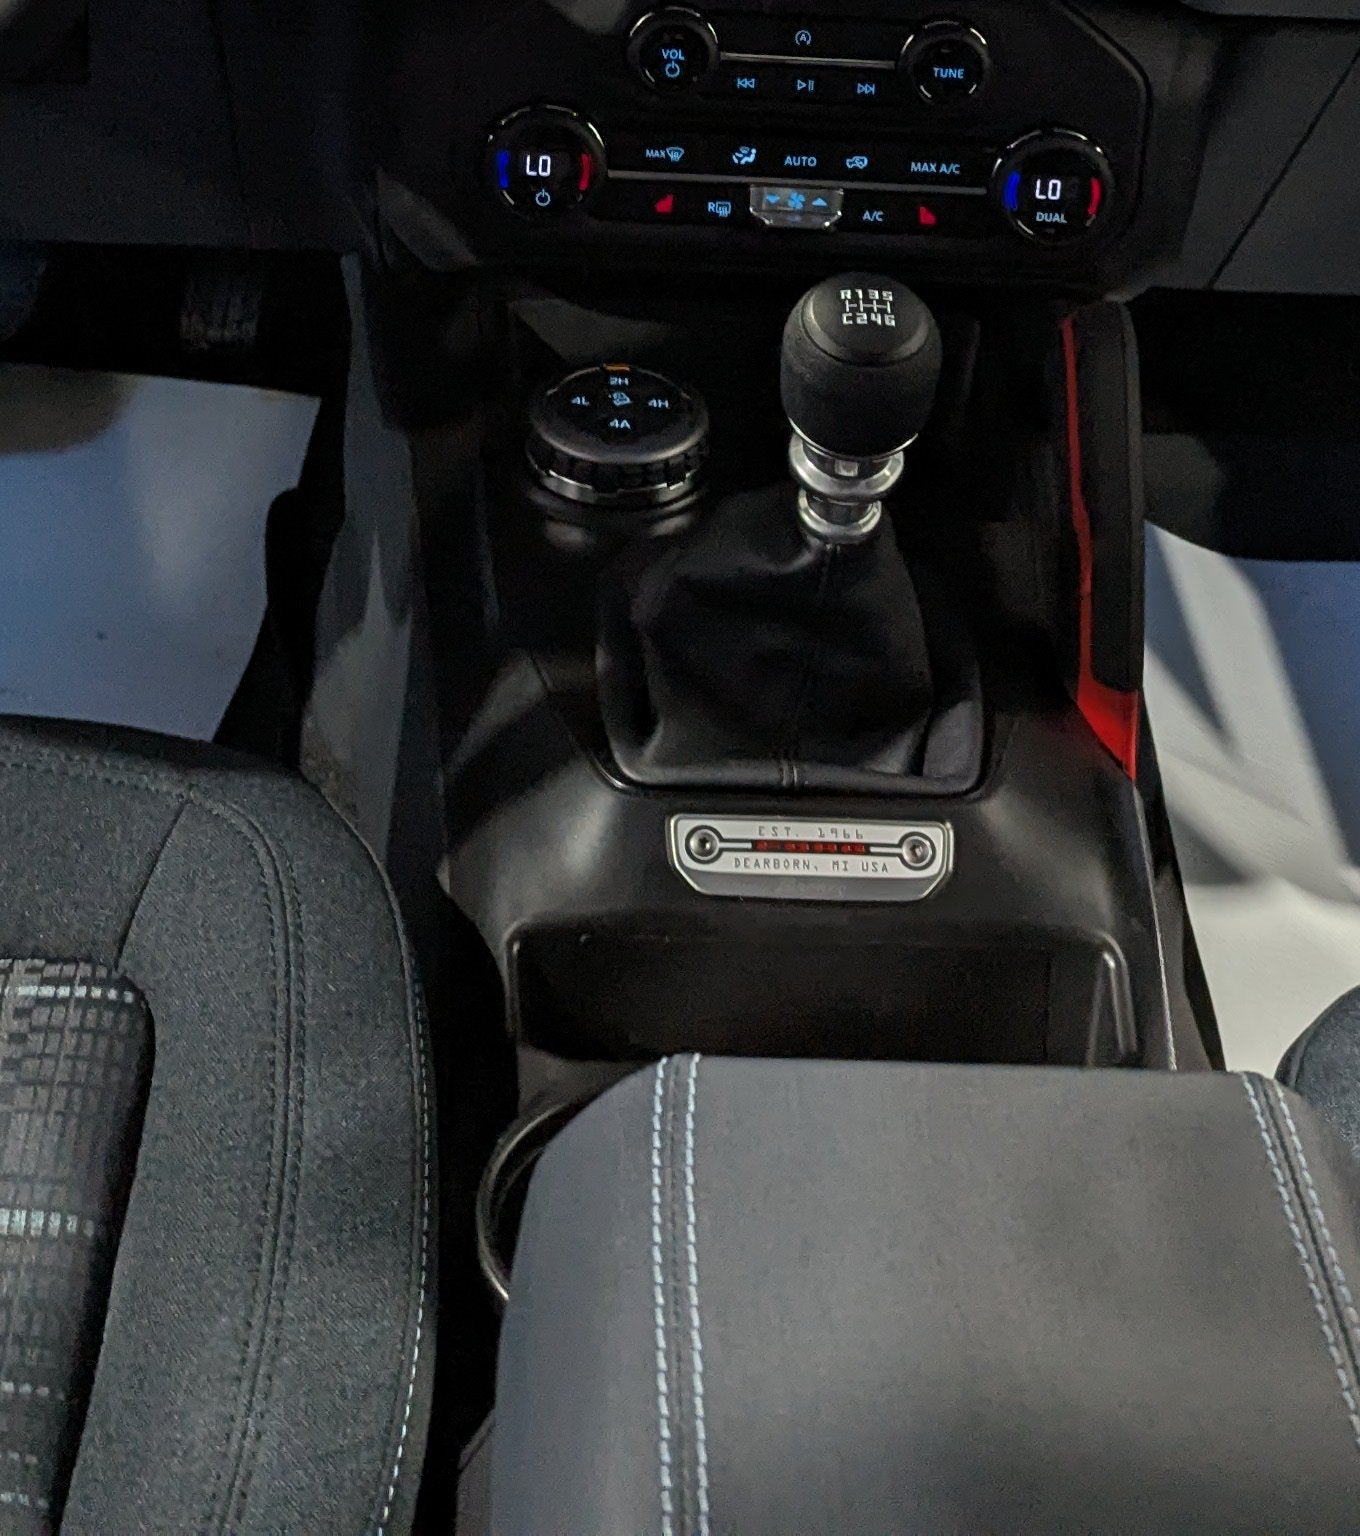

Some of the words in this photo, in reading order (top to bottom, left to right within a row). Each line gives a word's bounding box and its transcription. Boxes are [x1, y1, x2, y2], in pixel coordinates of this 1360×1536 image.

[661, 48, 685, 61] VOL
[933, 66, 965, 80] TUNE
[645, 149, 666, 159] MAX
[525, 154, 552, 177] LO
[784, 155, 817, 167] AUTO
[910, 162, 937, 173] MAX
[939, 163, 960, 175] A/C
[1034, 178, 1062, 201] LO
[708, 202, 716, 213] R
[862, 211, 884, 223] A/C
[1035, 212, 1067, 224] DUAL
[647, 398, 670, 409] 4H
[609, 418, 631, 429] 4A
[758, 825, 800, 838] EST.
[817, 827, 865, 840] 1966
[734, 857, 819, 872] DEARBORN,
[832, 860, 849, 871] MI
[861, 861, 890, 874] USA
